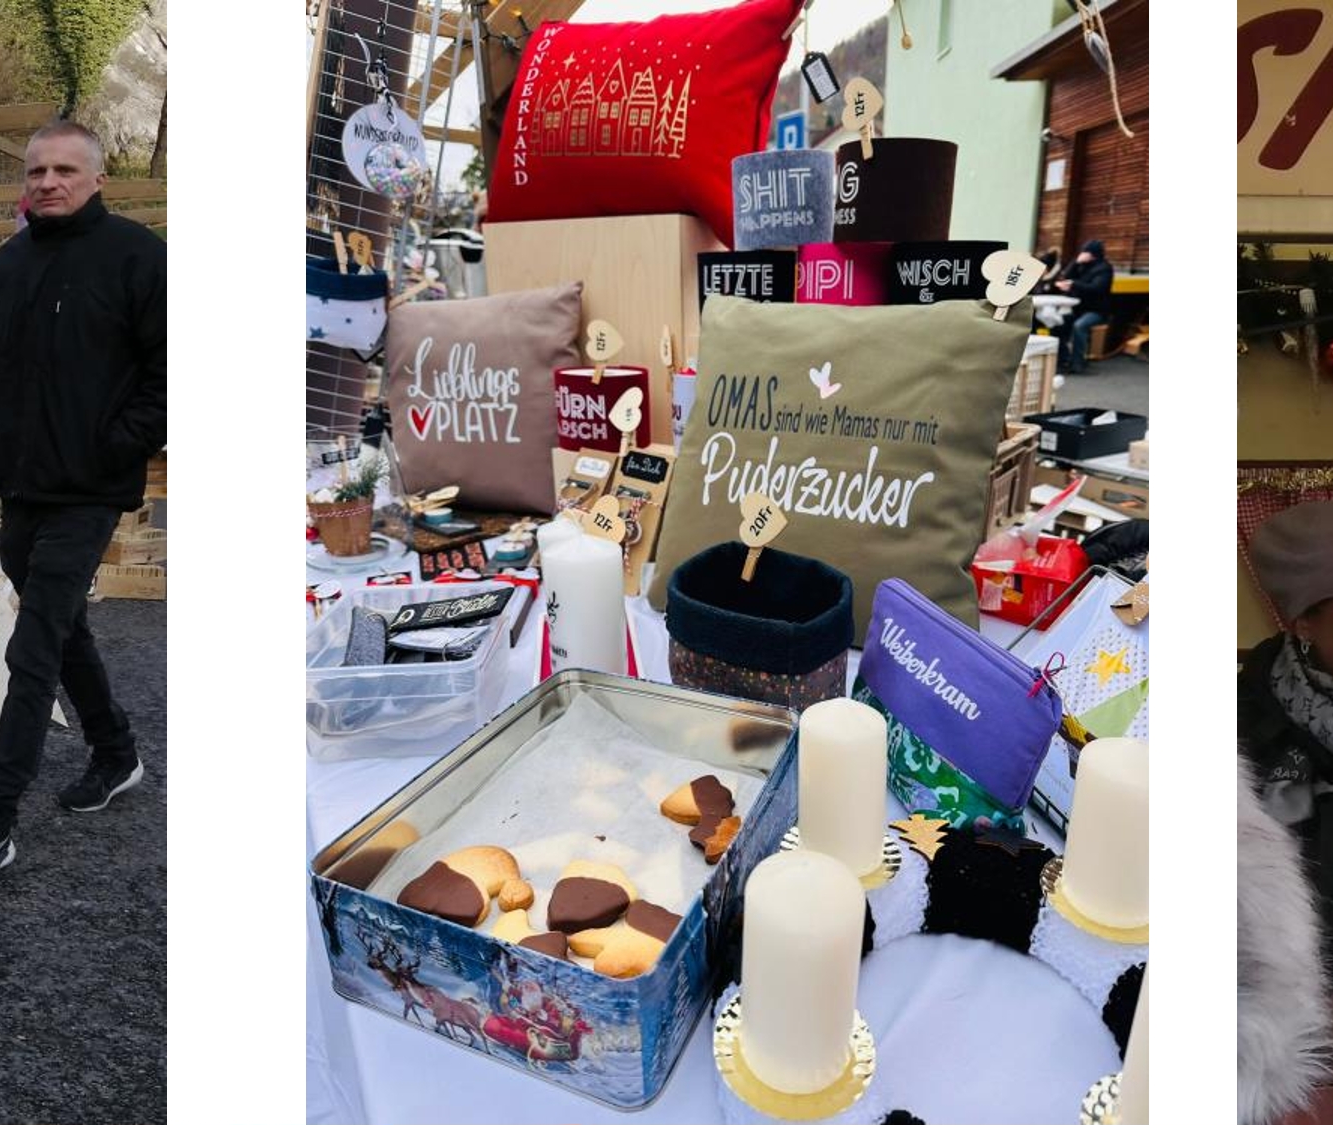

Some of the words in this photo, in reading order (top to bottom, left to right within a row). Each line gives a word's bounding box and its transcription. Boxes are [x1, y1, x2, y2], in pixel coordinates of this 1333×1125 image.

[513, 26, 565, 186] WONDERLAND
[854, 92, 866, 118] 12Fr
[740, 168, 811, 213] SHIT
[740, 209, 815, 231] HAPPENS
[703, 264, 773, 296] LETZTE
[897, 259, 970, 287] WISCH
[1004, 264, 1025, 287] 18Fr
[405, 336, 520, 411] Lieblings
[435, 402, 521, 443] PLATZ
[707, 374, 778, 430] OMAS
[774, 403, 803, 433] sind
[804, 405, 828, 435] wie
[831, 404, 880, 439] Mamas
[882, 417, 909, 440] nur
[912, 414, 940, 445] mit
[701, 431, 935, 528] Puderzucker
[593, 512, 613, 532] 12Fr
[749, 504, 773, 537] 20Fr
[878, 616, 982, 722] Weiberkram
